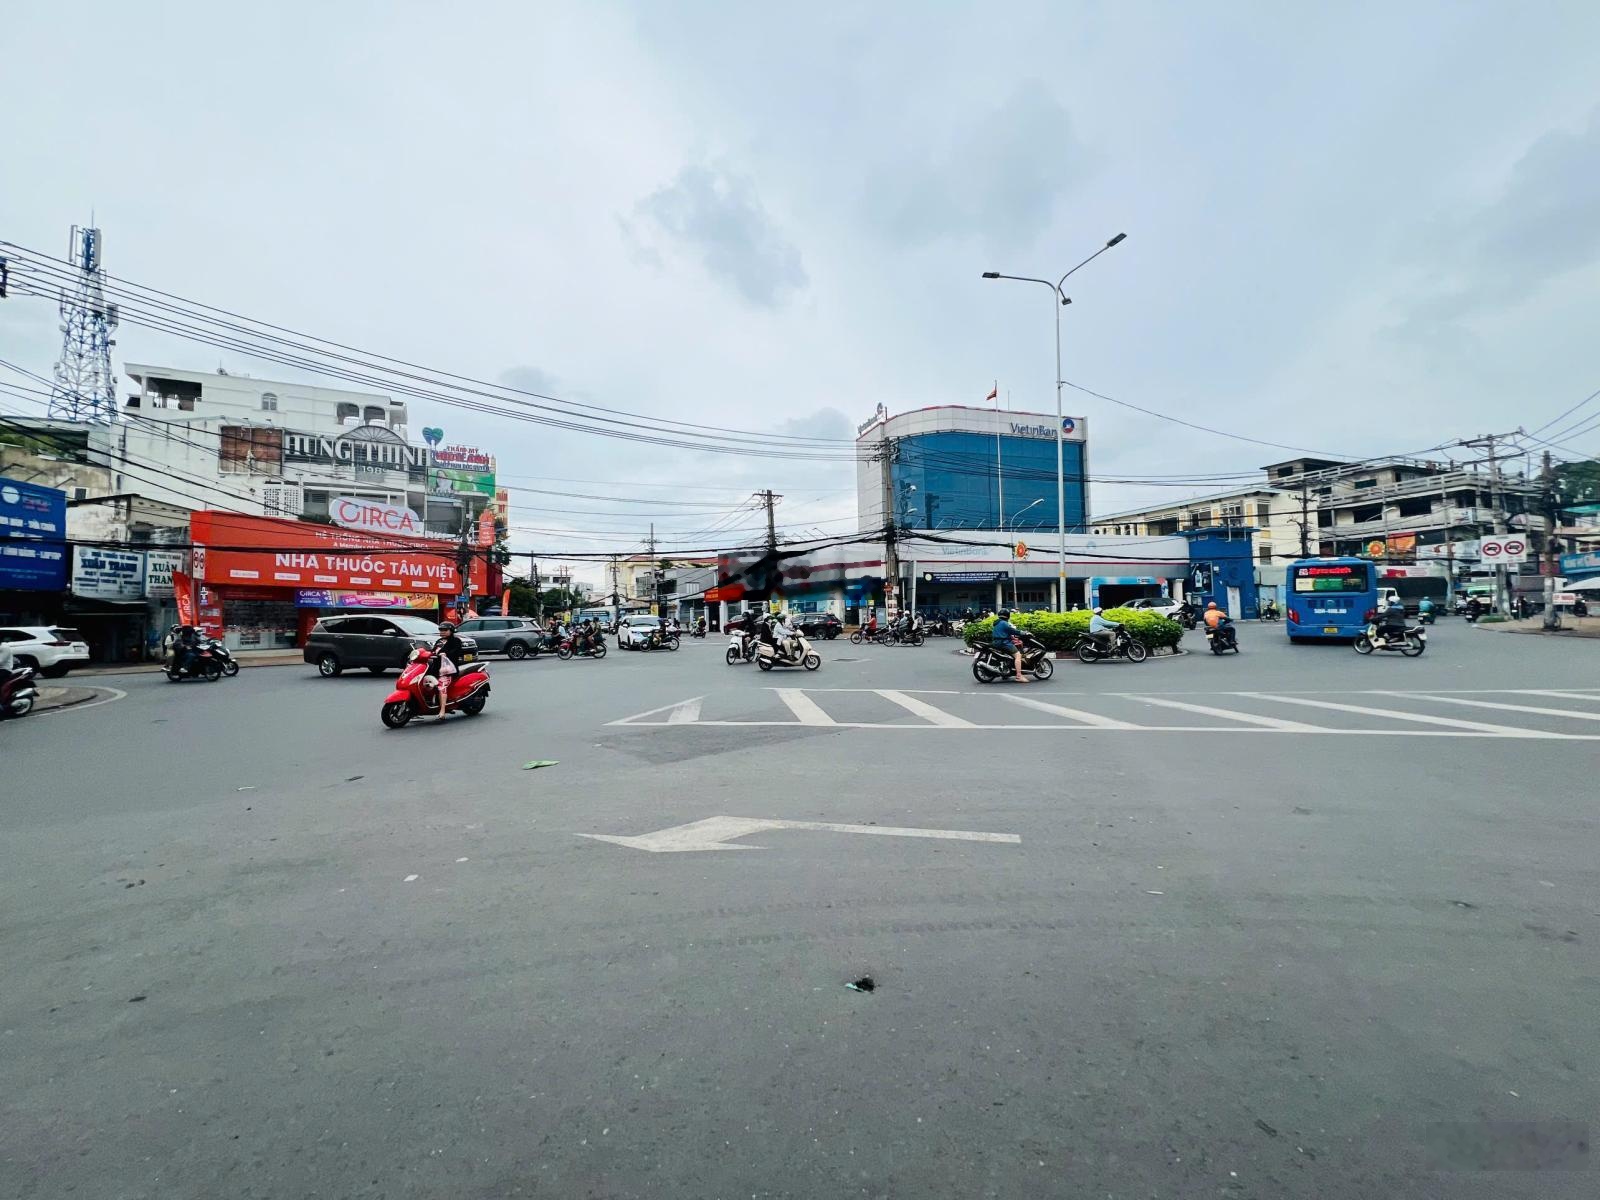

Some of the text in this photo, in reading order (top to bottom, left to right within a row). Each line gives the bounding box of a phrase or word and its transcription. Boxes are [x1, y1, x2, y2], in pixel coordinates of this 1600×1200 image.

[1010, 421, 1058, 437] VietinBan
[338, 500, 414, 532] CIRCA
[324, 554, 386, 574] THUỐC
[390, 559, 423, 577] TÂM
[425, 562, 456, 581] VIỆT
[148, 574, 174, 584] THAN
